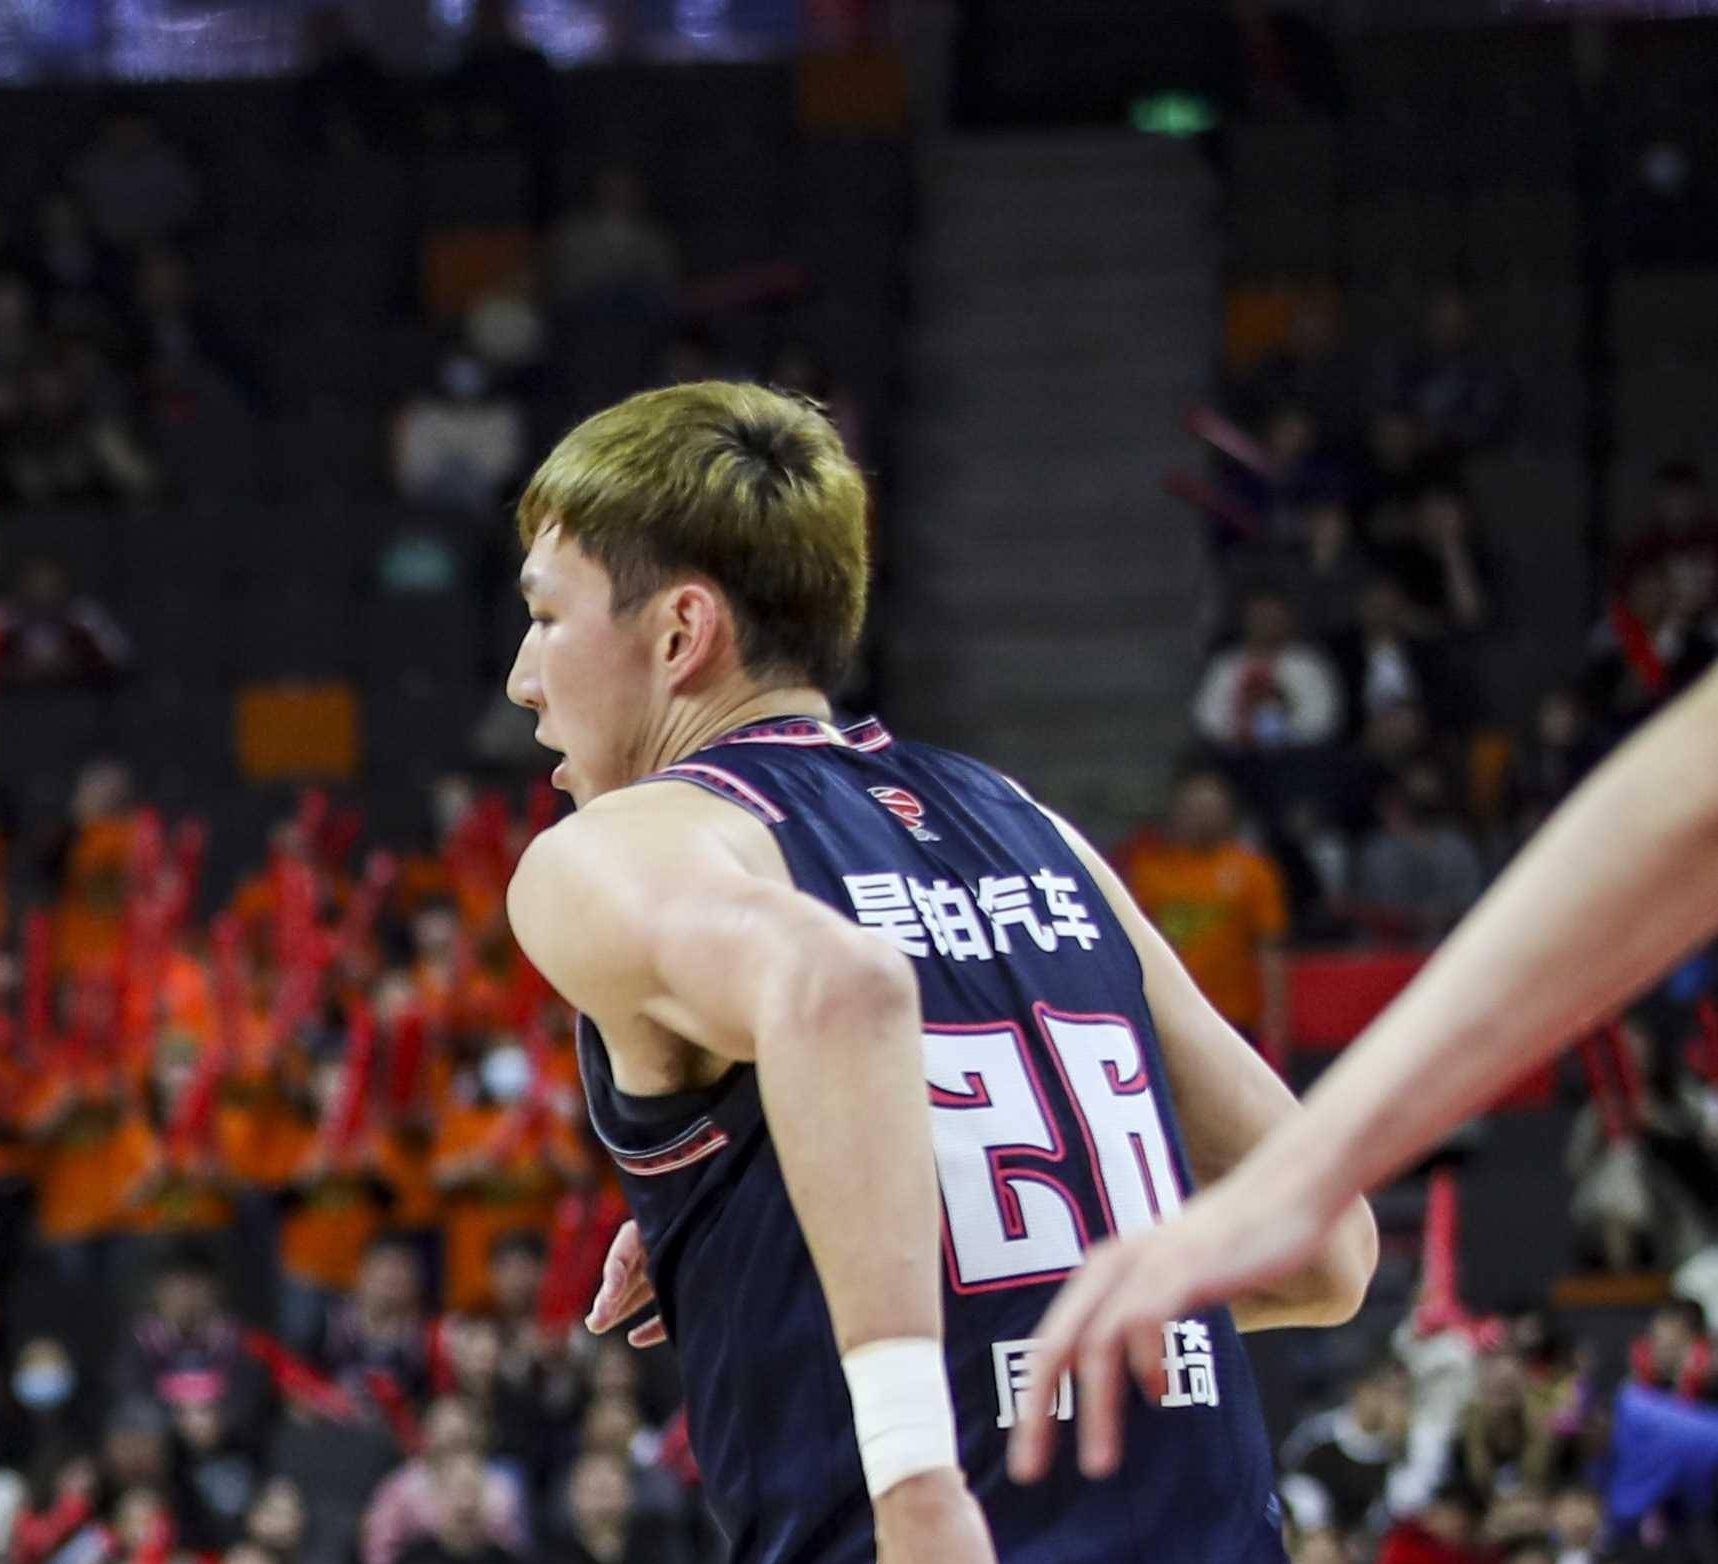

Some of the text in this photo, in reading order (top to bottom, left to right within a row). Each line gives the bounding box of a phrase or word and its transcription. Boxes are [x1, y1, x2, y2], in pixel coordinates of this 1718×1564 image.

[841, 867, 1101, 962] 昊铂汽车
[921, 1001, 1199, 1296] 26
